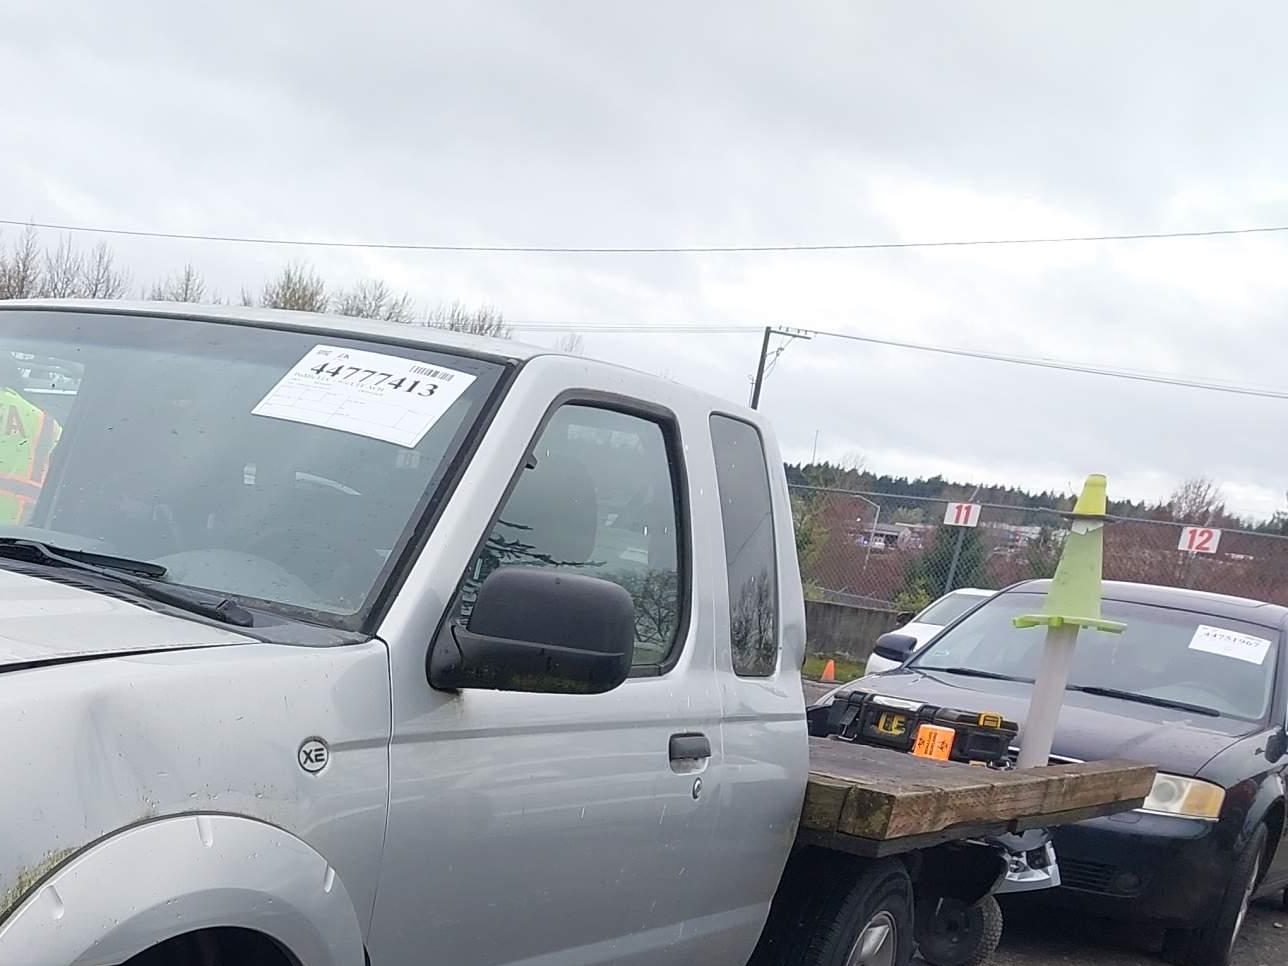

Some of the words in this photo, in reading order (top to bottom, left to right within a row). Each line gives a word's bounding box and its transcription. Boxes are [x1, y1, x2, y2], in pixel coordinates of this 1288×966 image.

[310, 361, 439, 398] 44777413
[954, 503, 973, 525] 11
[1187, 528, 1214, 551] 12
[302, 747, 326, 765] XE
